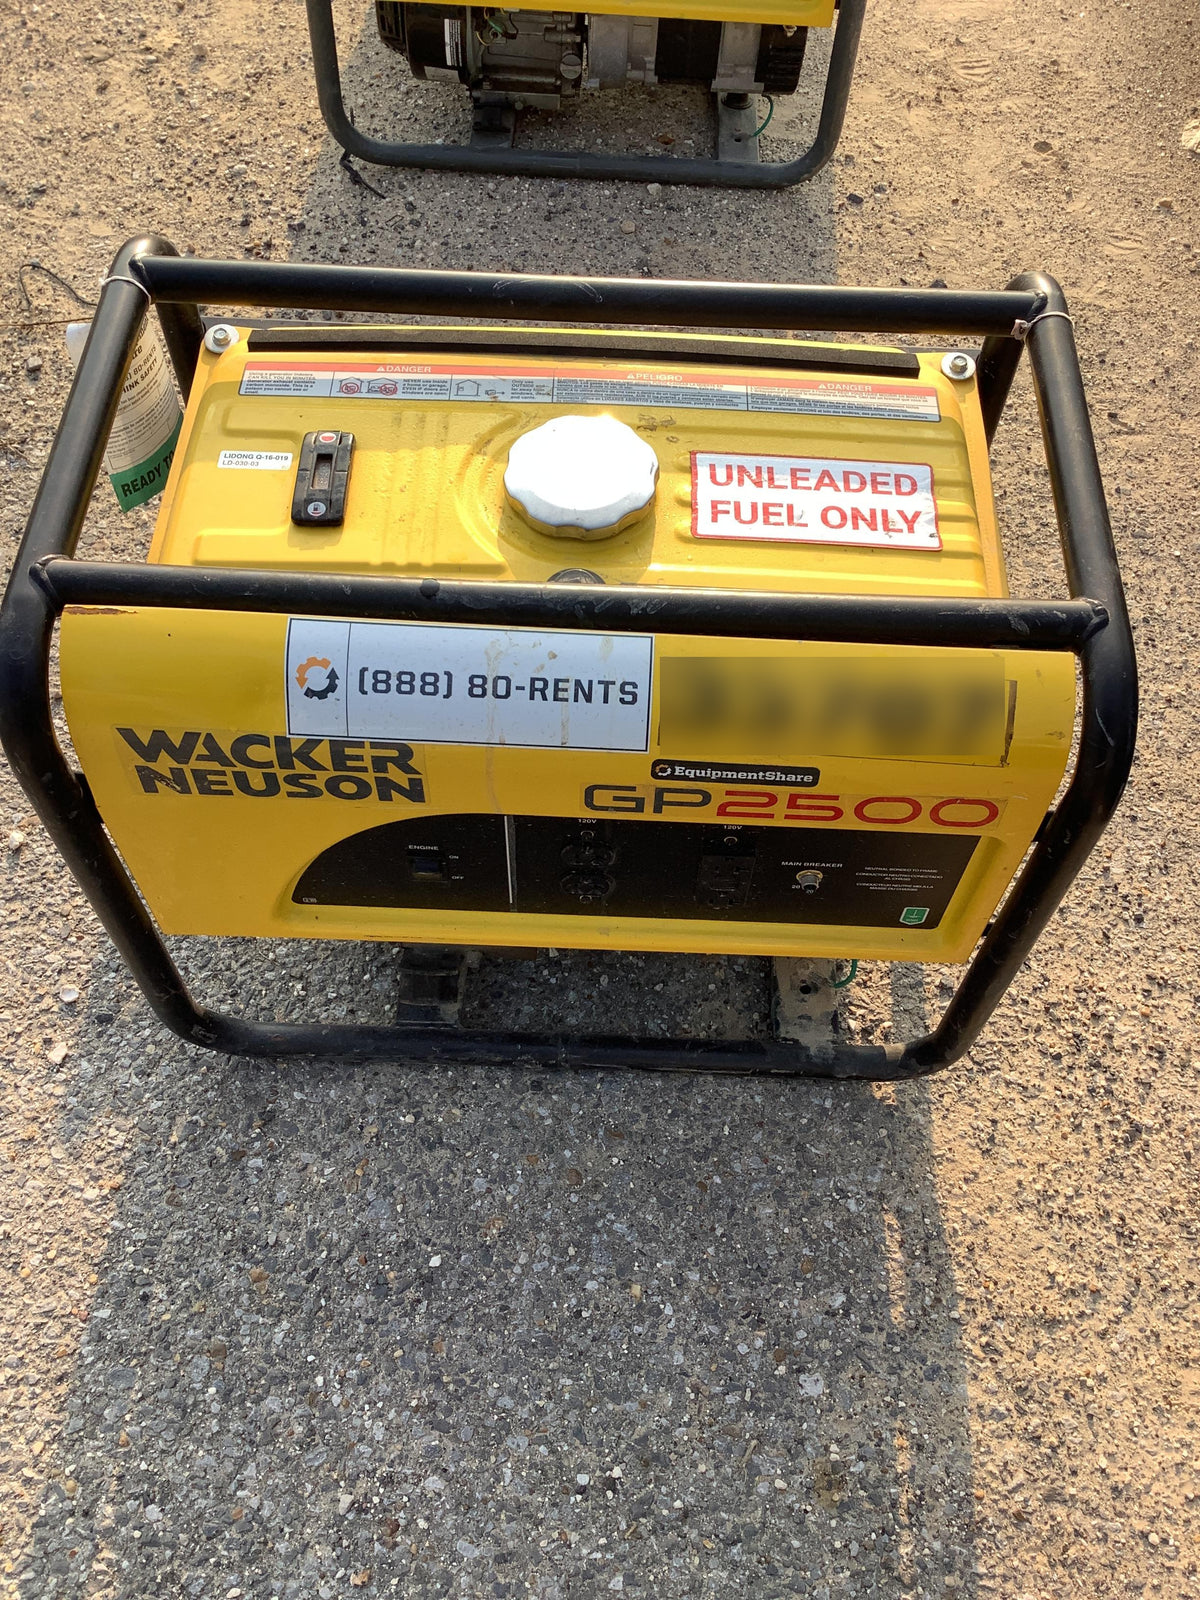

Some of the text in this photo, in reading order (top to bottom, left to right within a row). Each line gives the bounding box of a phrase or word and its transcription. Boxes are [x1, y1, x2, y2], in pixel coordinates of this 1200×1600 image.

[140, 357, 159, 382] SAFETY
[386, 365, 431, 373] DANGER
[635, 373, 683, 382] PELIGRO
[827, 383, 872, 392] DANGER
[121, 462, 162, 498] READY
[708, 463, 918, 497] UNLEADED
[710, 499, 923, 535] FUEL ONLY
[358, 666, 640, 706] (888) 80-RENTS
[116, 727, 424, 776] WACKER
[134, 764, 427, 803] NEUSON
[673, 764, 815, 784] EquipmentShare
[583, 783, 1000, 828] GP2500
